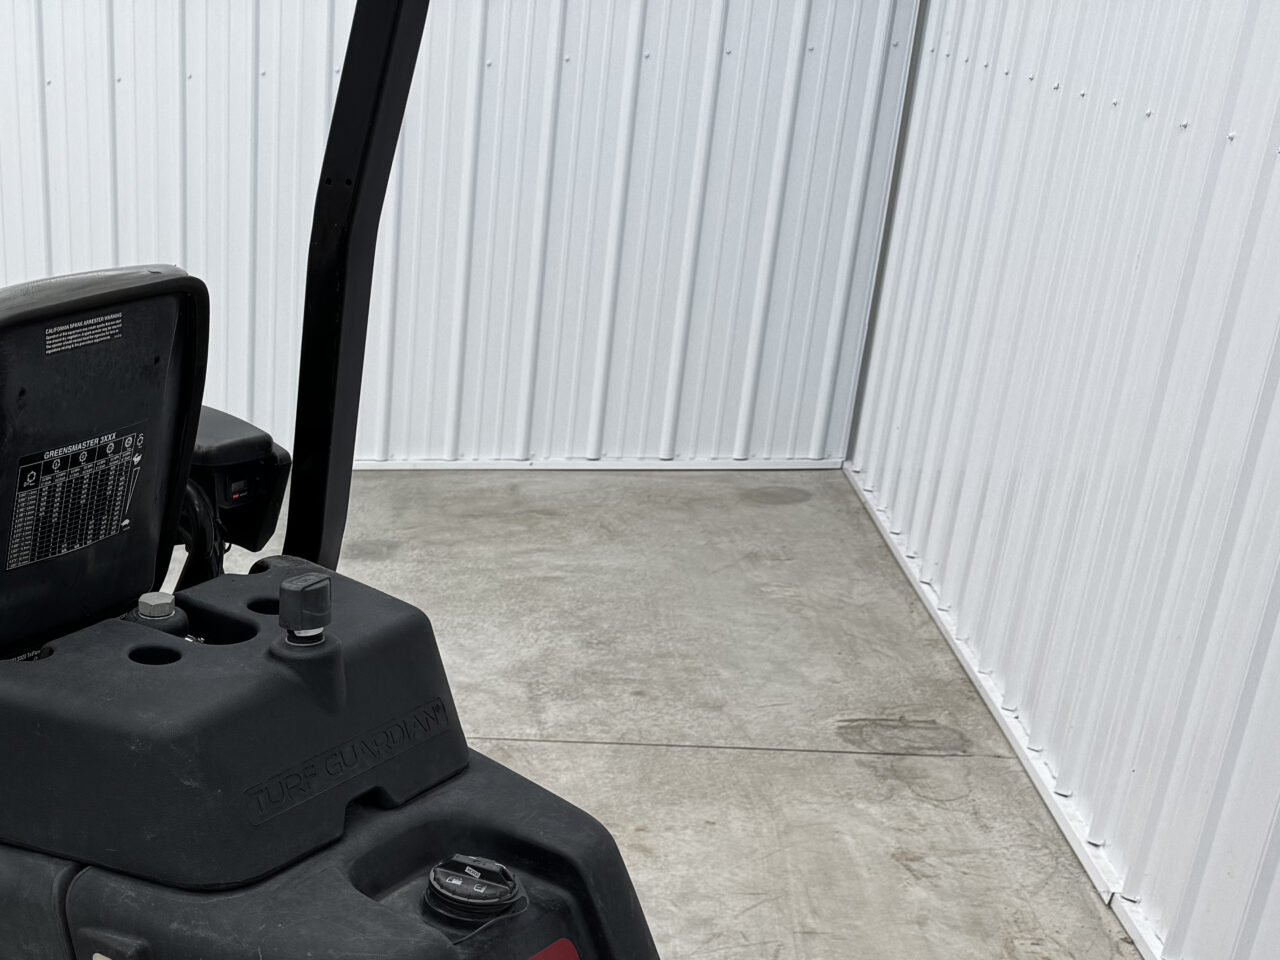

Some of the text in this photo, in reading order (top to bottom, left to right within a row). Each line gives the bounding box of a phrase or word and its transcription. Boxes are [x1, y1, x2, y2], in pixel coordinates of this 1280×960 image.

[43, 437, 99, 460] GREENSMASTER
[244, 704, 440, 814] TURF GUARDIAN
